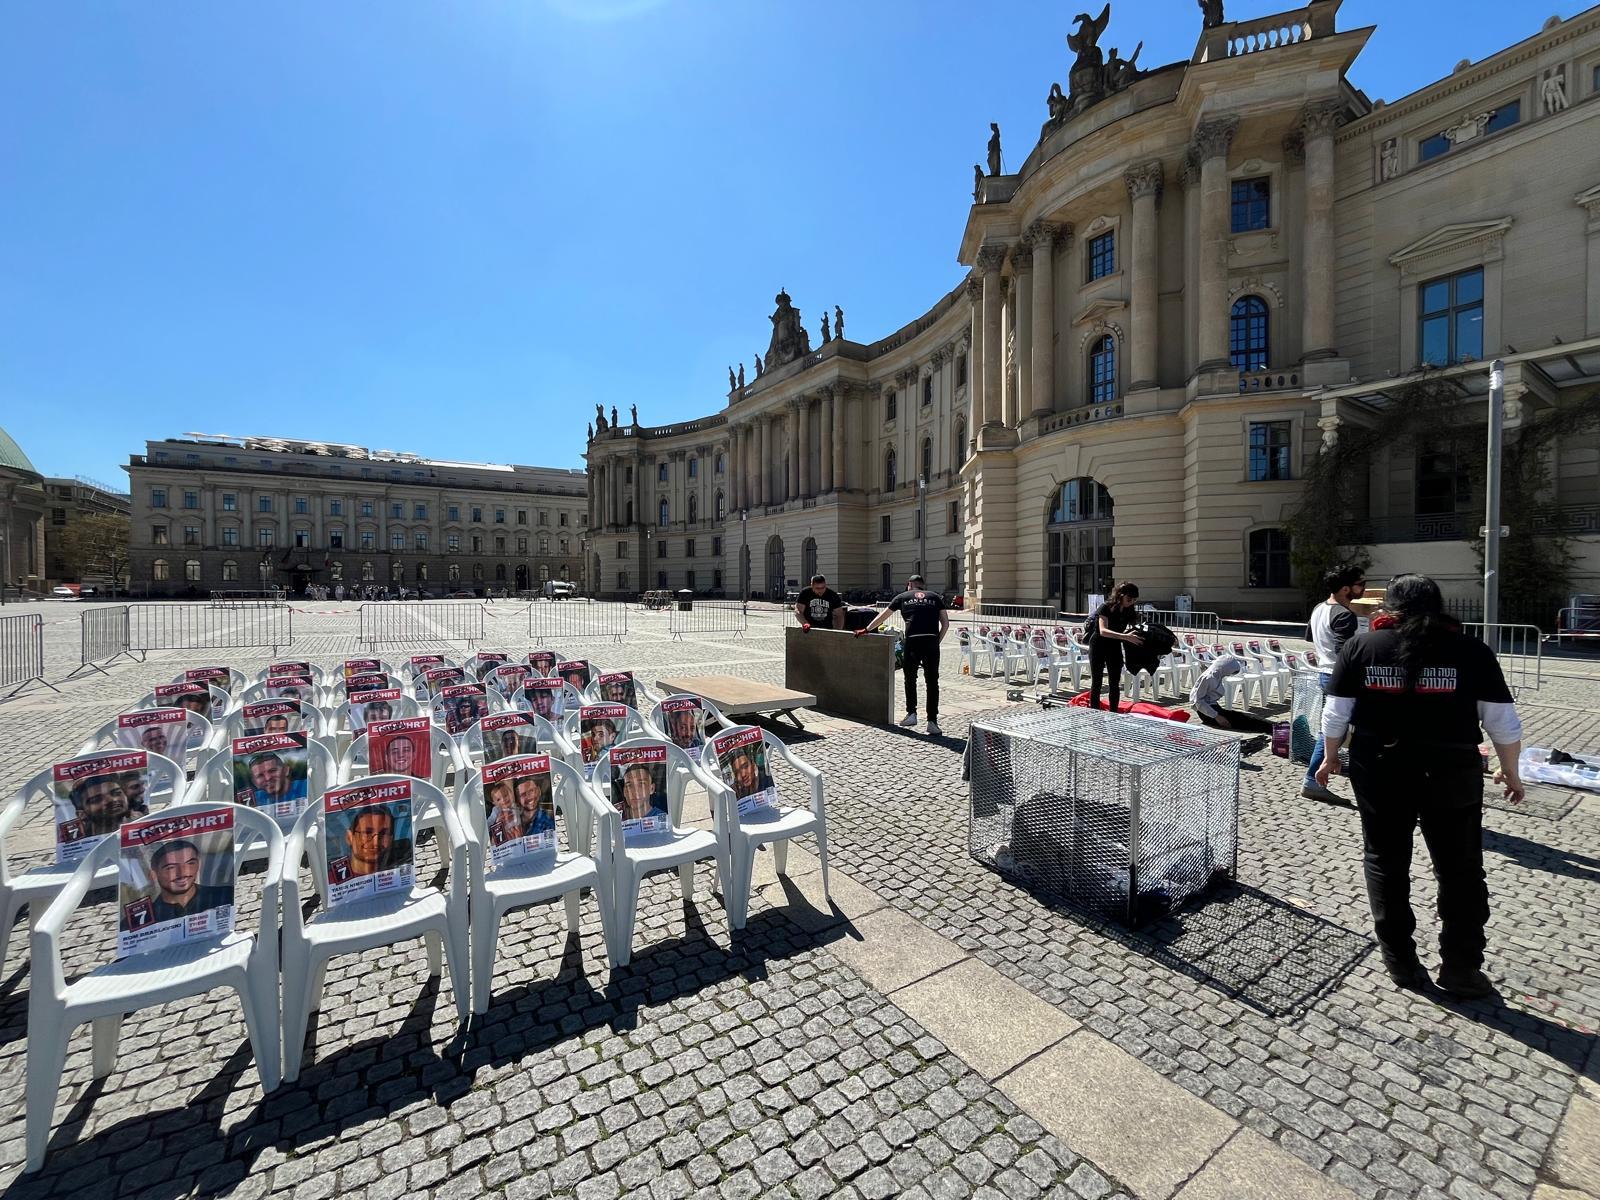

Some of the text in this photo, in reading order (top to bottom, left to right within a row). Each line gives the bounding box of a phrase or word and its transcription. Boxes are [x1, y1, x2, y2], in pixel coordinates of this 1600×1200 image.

[1437, 667, 1457, 678] מטה
[1414, 677, 1457, 690] החטופי
[122, 712, 183, 724] ENTHRT
[371, 720, 427, 733] ENTHRT
[717, 730, 759, 750] ENTHRT
[613, 749, 664, 761] ENTHRT
[60, 755, 143, 776] ENTHRT
[485, 759, 546, 778] ENTHRT
[329, 785, 407, 806] ENTHRT
[127, 813, 228, 840] ENTHRT
[337, 866, 347, 880] 7
[134, 910, 148, 925] 7
